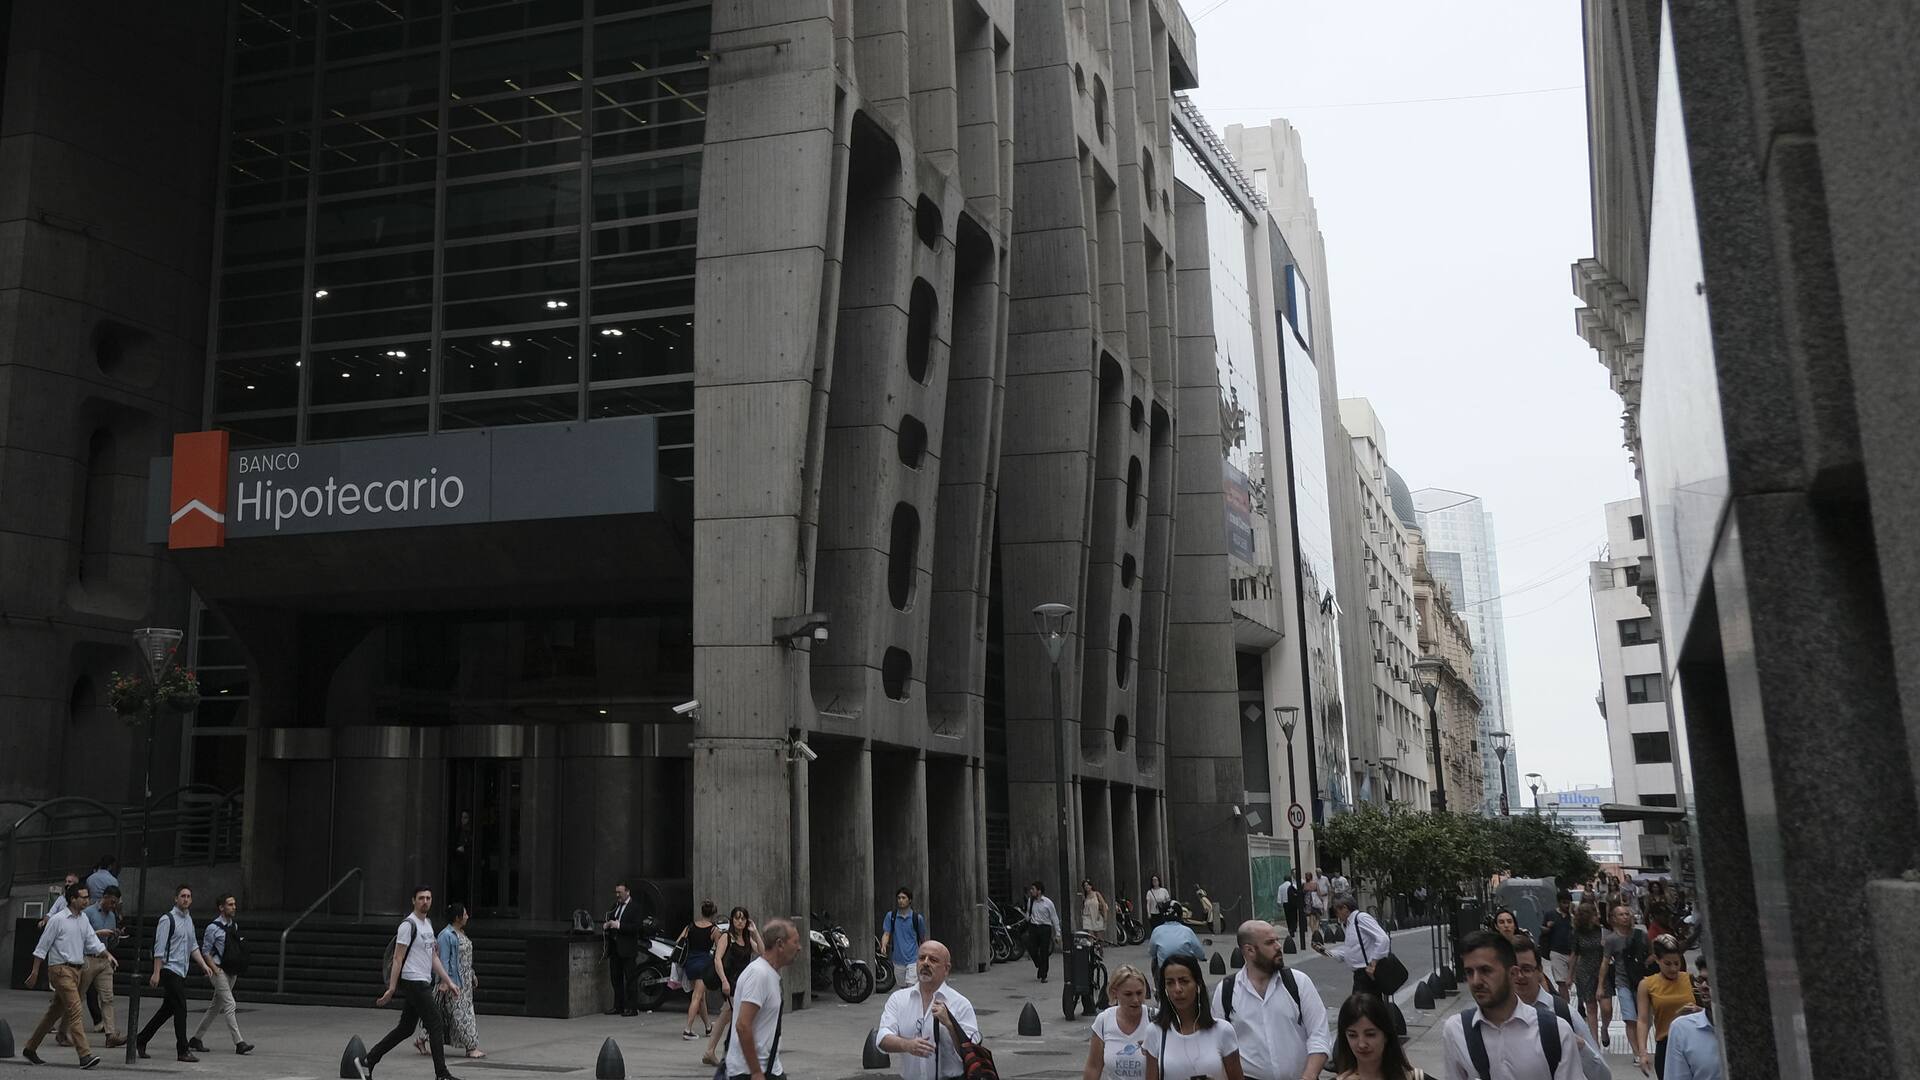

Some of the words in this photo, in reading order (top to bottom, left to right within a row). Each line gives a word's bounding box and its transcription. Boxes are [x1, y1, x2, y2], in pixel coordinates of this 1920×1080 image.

[239, 452, 299, 473] BANCO
[237, 467, 464, 531] Hipotecario
[1558, 793, 1600, 804] Hilton
[1115, 1059, 1141, 1070] KEEP
[1115, 1069, 1142, 1077] CALM
